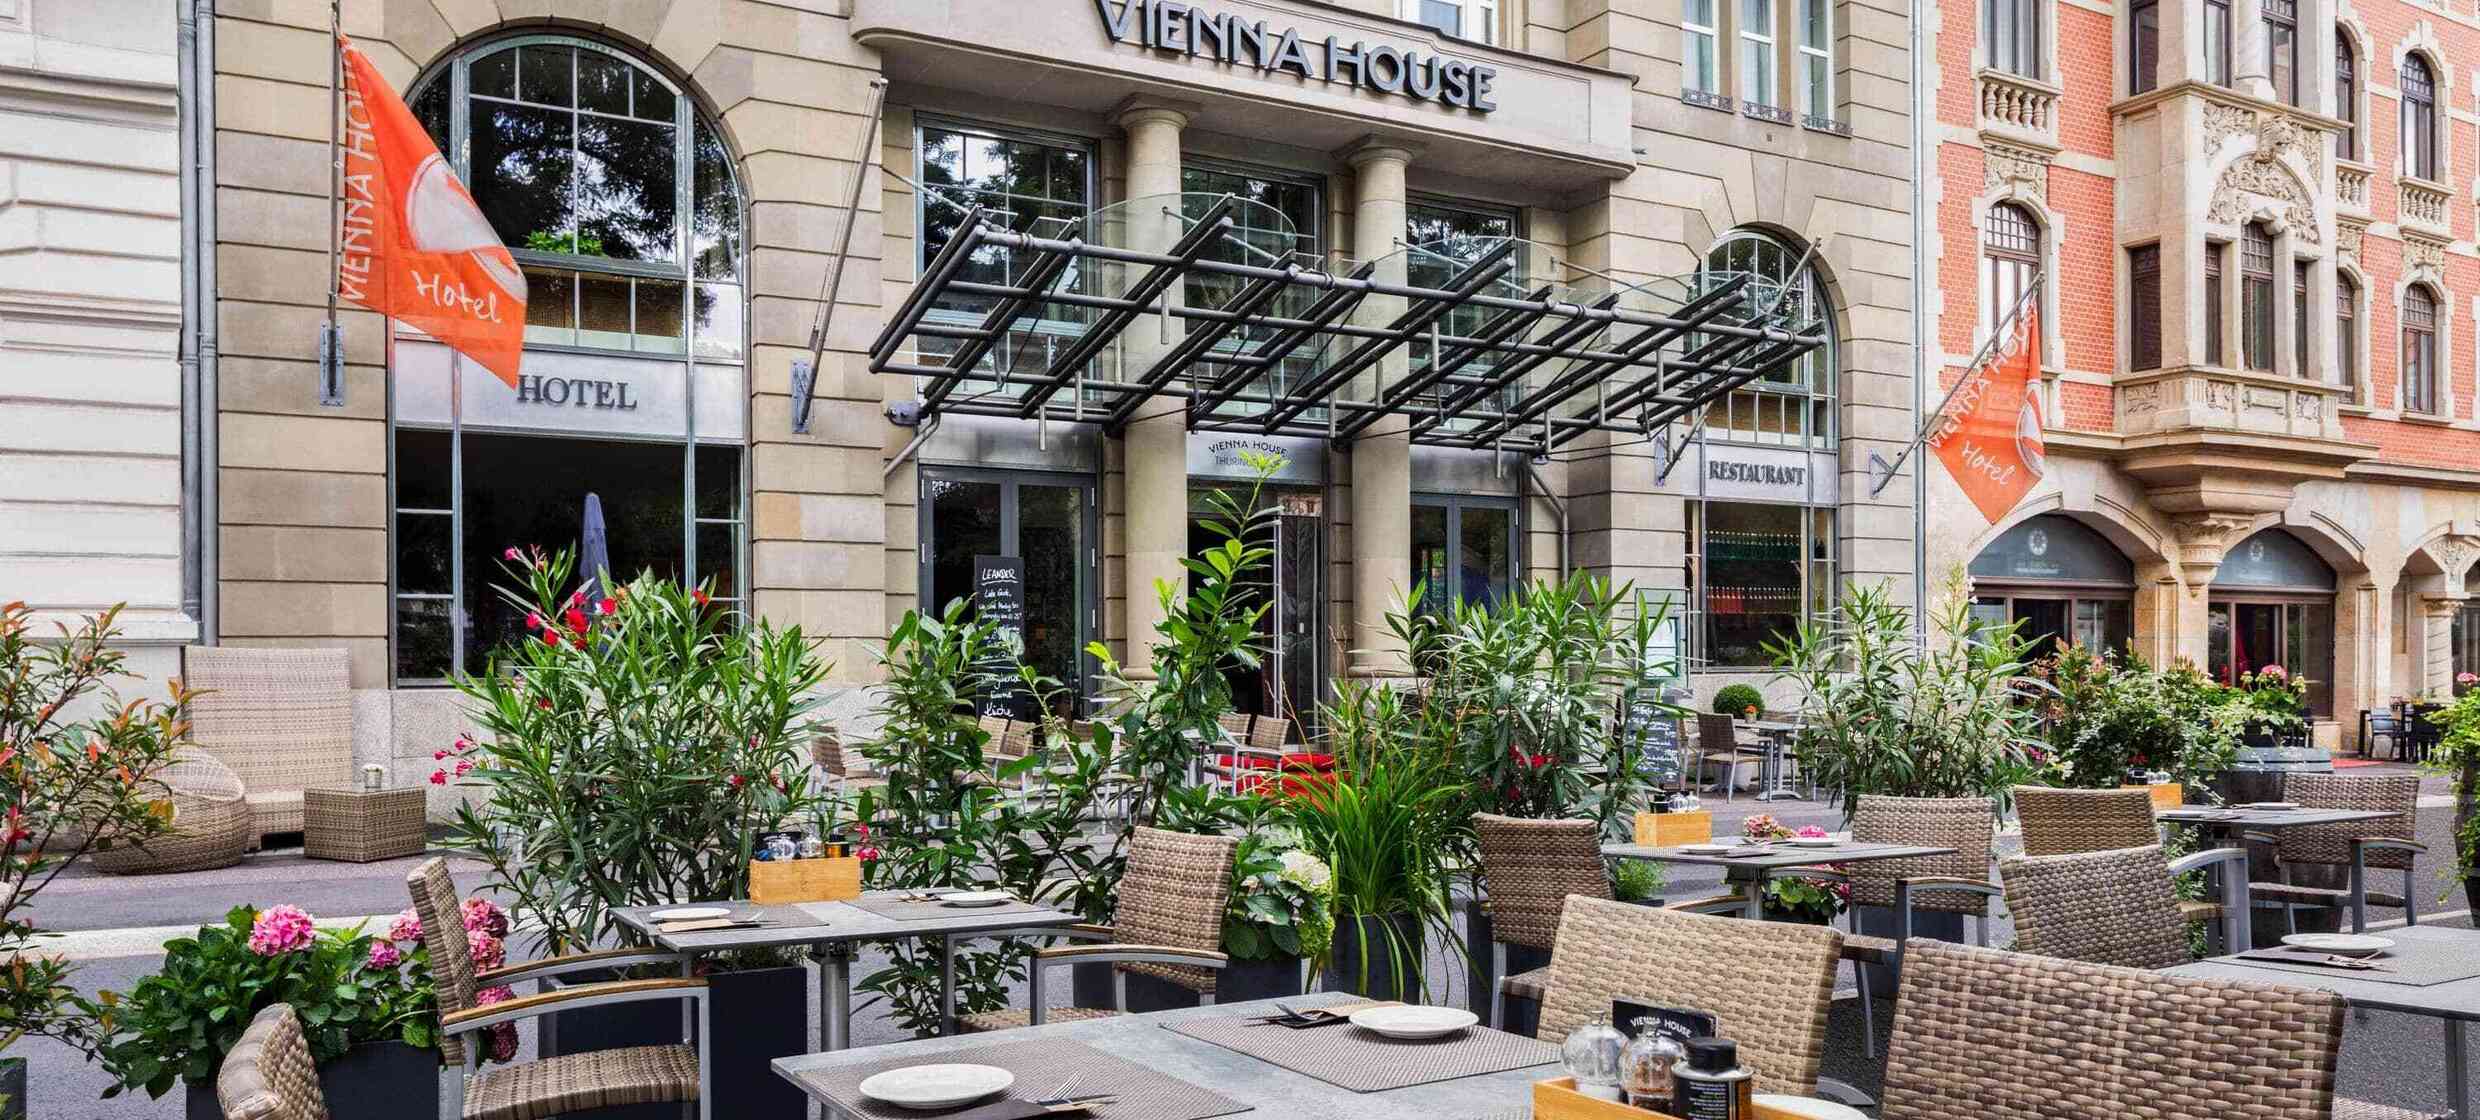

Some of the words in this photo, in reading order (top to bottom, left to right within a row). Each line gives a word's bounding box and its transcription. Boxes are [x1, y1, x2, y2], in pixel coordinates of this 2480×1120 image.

[1097, 0, 1313, 78] VIENNA
[1325, 35, 1497, 113] HOUSE
[339, 173, 374, 300] VIENNA
[411, 271, 501, 323] Hotel
[517, 374, 638, 411] HOTEL
[1208, 440, 1249, 454] VIENNA
[1253, 441, 1288, 458] HOUSE
[1962, 439, 2016, 486] Hotel
[1709, 461, 1806, 486] RESTAURANT
[1664, 1019, 1692, 1039] HOUSE
